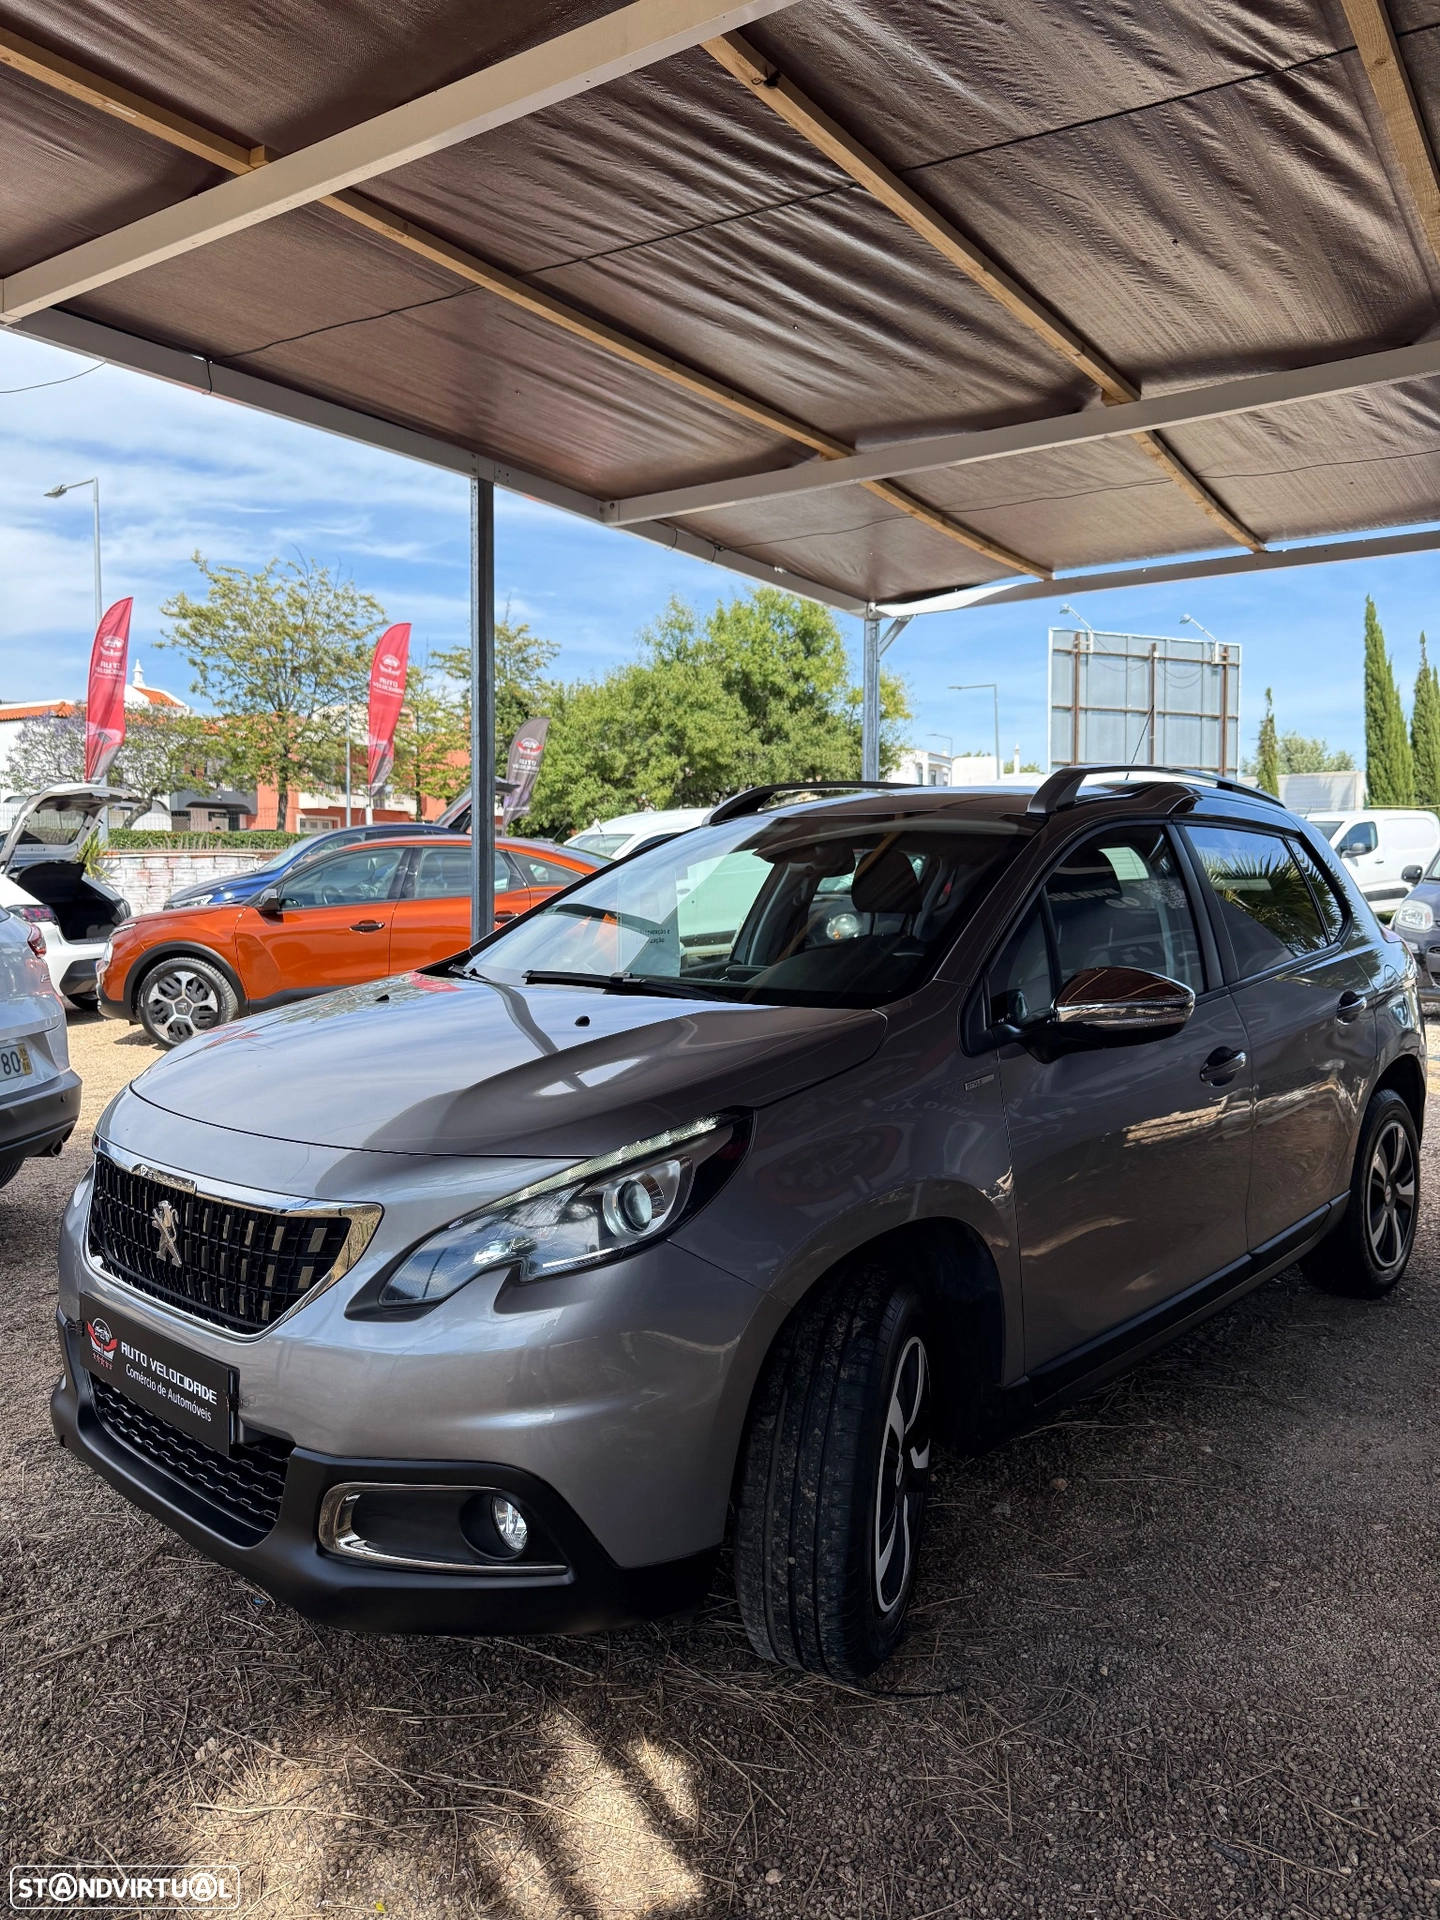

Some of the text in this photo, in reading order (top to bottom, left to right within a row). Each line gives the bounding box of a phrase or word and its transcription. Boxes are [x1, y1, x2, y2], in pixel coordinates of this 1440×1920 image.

[1, 1051, 21, 1076] 80
[121, 1342, 217, 1405] AUTO VELOCIDADE
[125, 1364, 211, 1422] Comércio de Automóveis
